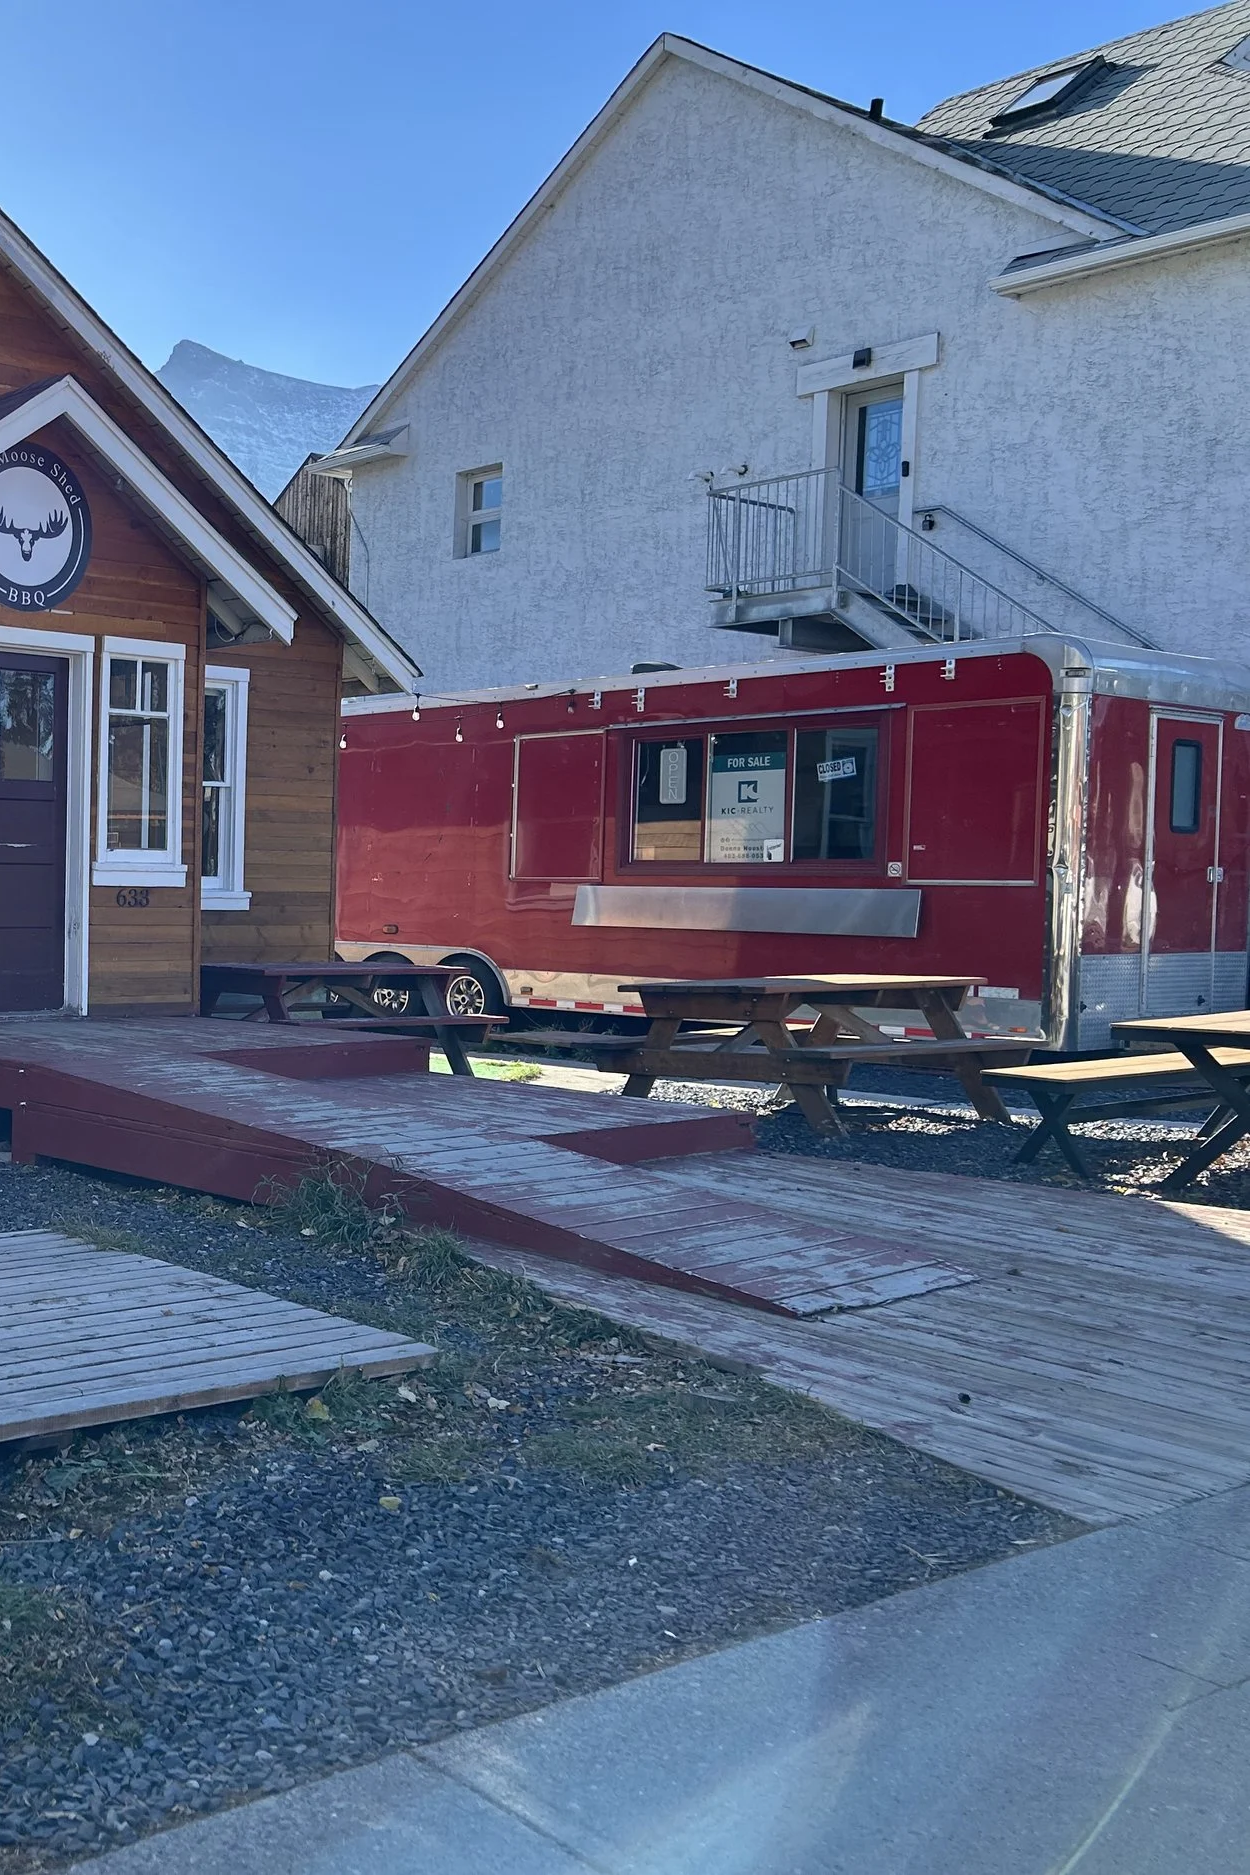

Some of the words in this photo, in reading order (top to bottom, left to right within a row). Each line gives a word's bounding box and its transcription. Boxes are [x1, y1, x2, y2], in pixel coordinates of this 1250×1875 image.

[50, 463, 82, 505] Shed
[7, 587, 46, 607] BBQ
[727, 757, 746, 769] FOR
[747, 756, 771, 768] SALE
[818, 761, 842, 775] CLOSED
[668, 751, 679, 800] OPEN
[721, 807, 737, 815] KIC
[740, 805, 775, 815] REALTY
